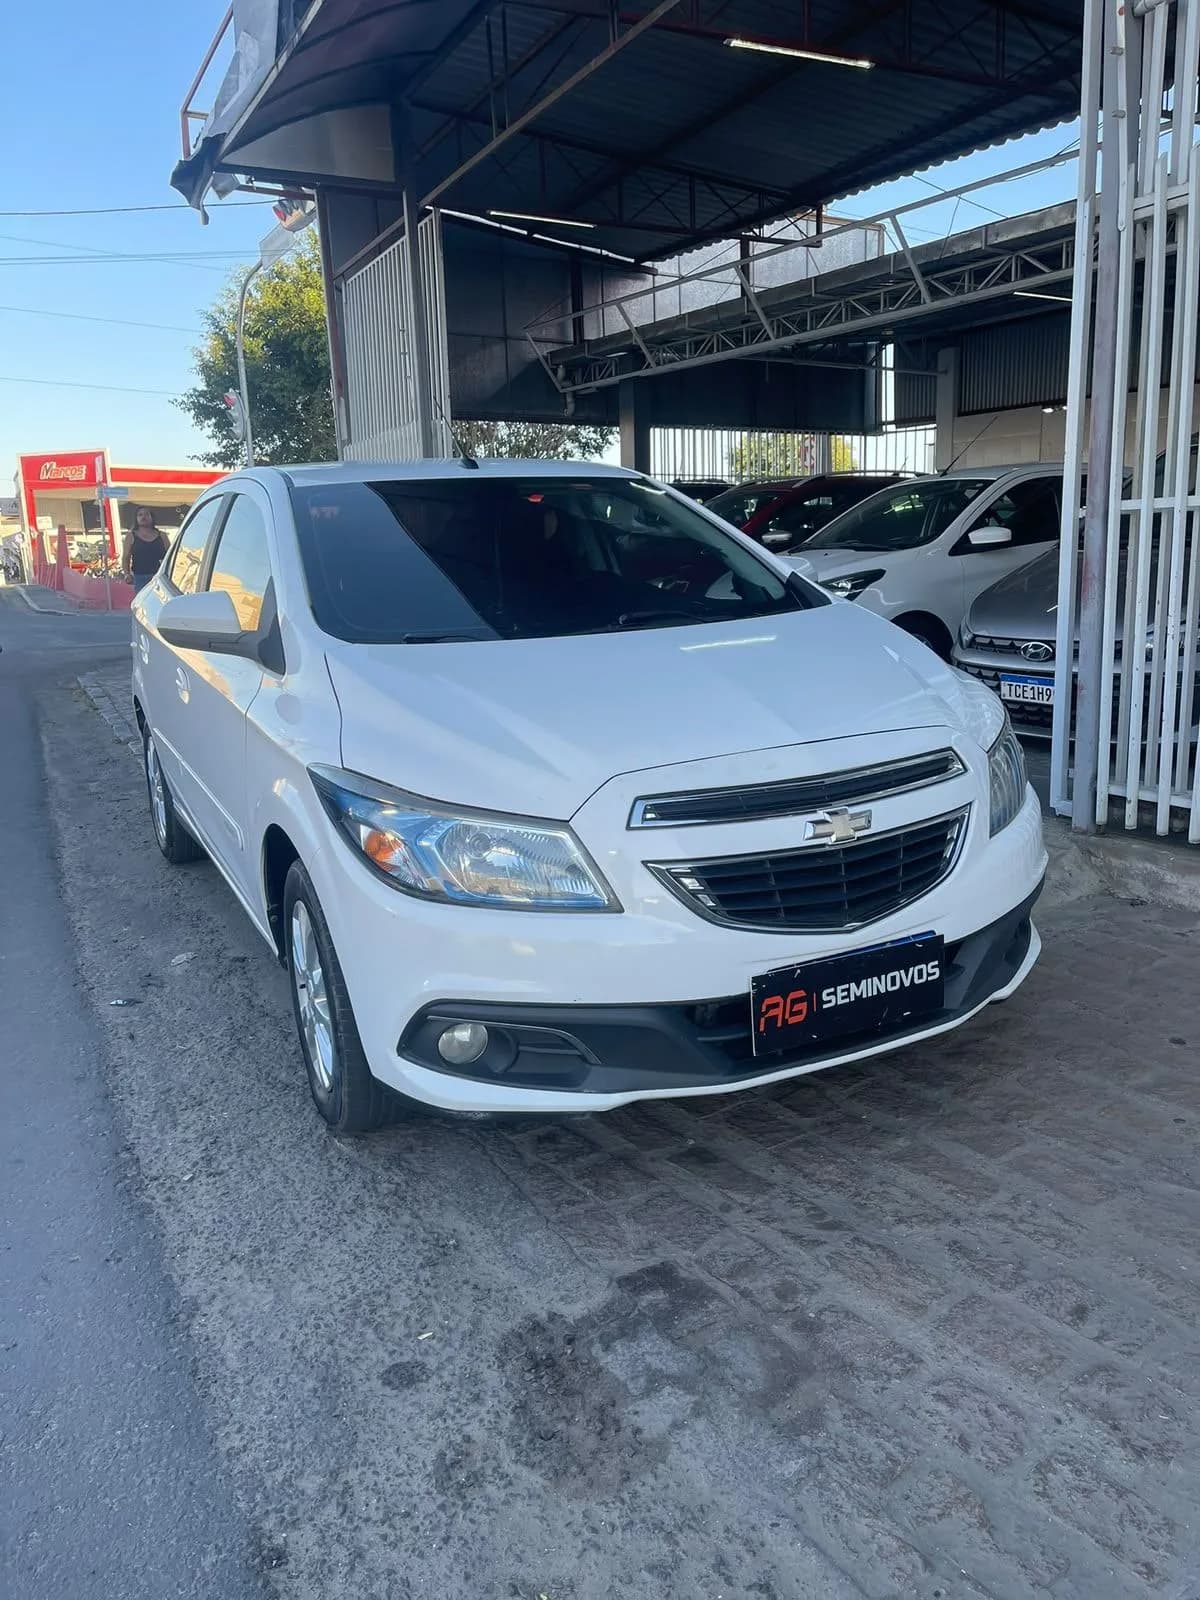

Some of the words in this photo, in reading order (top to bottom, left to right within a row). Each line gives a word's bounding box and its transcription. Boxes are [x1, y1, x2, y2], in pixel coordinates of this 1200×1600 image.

[1007, 683, 1055, 702] TCE1H9
[759, 990, 808, 1033] AG
[821, 960, 940, 1009] SEMINOVOS
